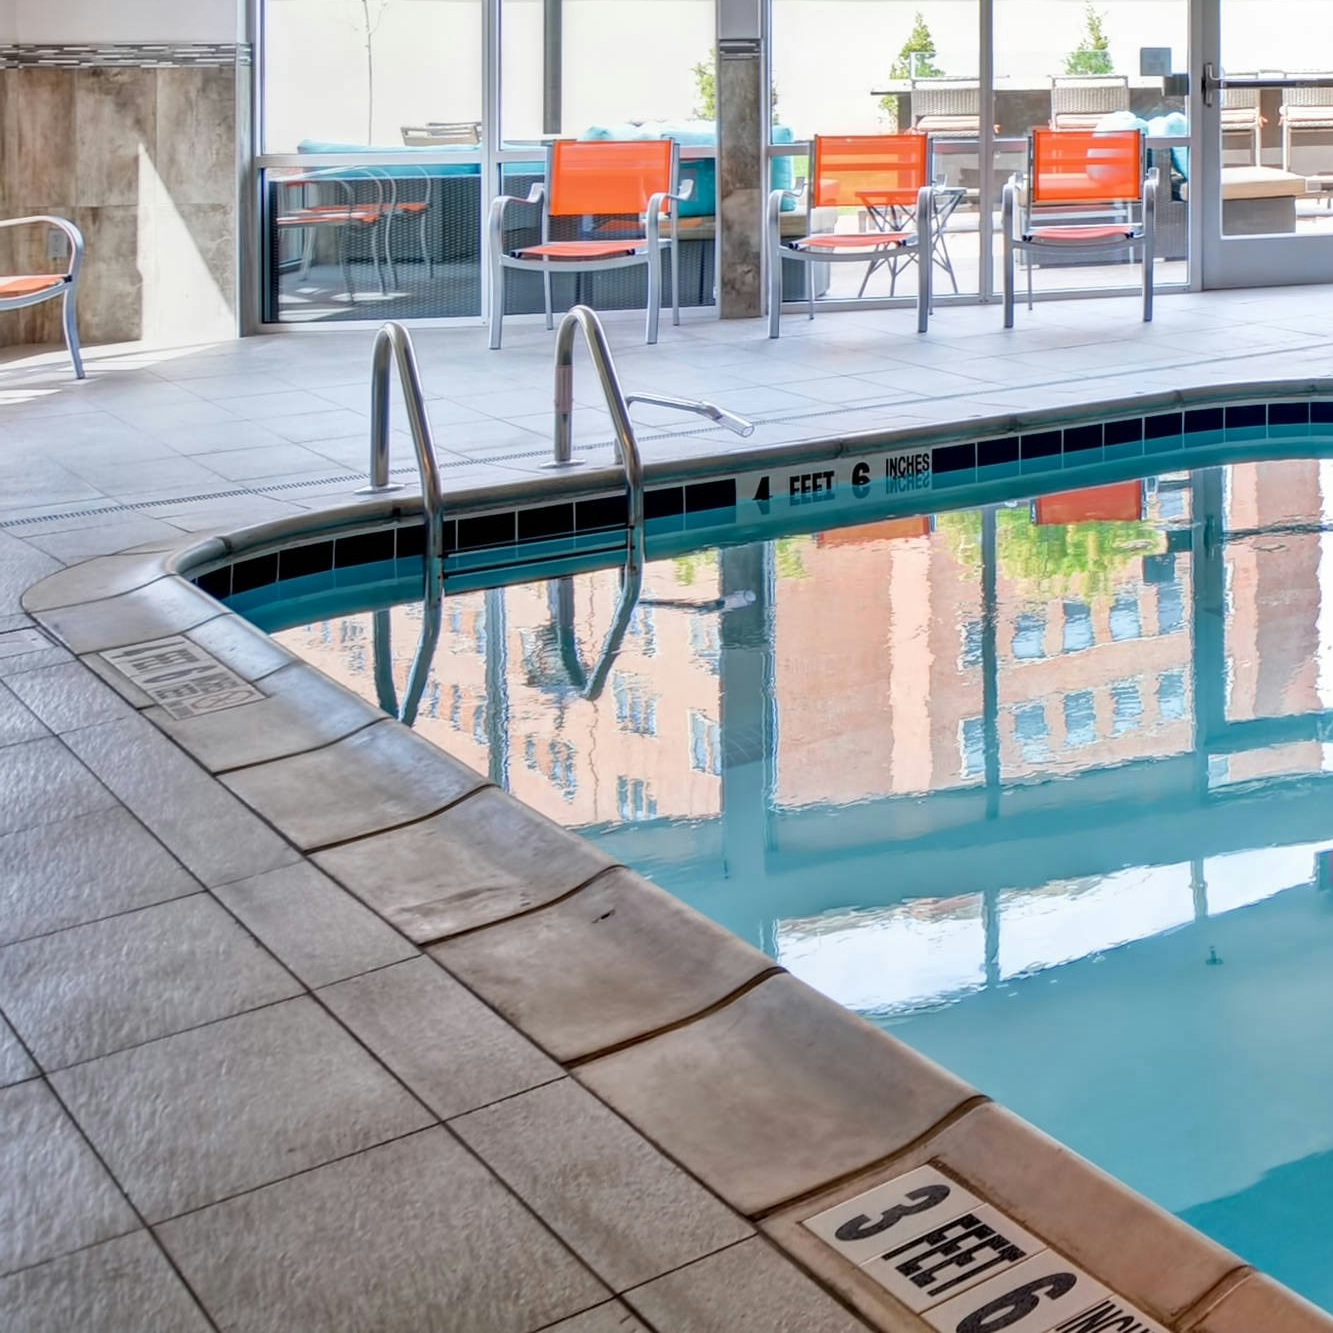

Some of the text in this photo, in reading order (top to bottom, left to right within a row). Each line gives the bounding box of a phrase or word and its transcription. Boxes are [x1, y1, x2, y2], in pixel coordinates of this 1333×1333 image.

[752, 452, 930, 501] 4 FEET 6 INCHES
[111, 640, 186, 659] 4
[127, 648, 200, 674] FEET
[143, 664, 219, 684] 6
[835, 1184, 951, 1242] 3
[881, 1213, 1027, 1297] FEET
[956, 1272, 1077, 1333] 6
